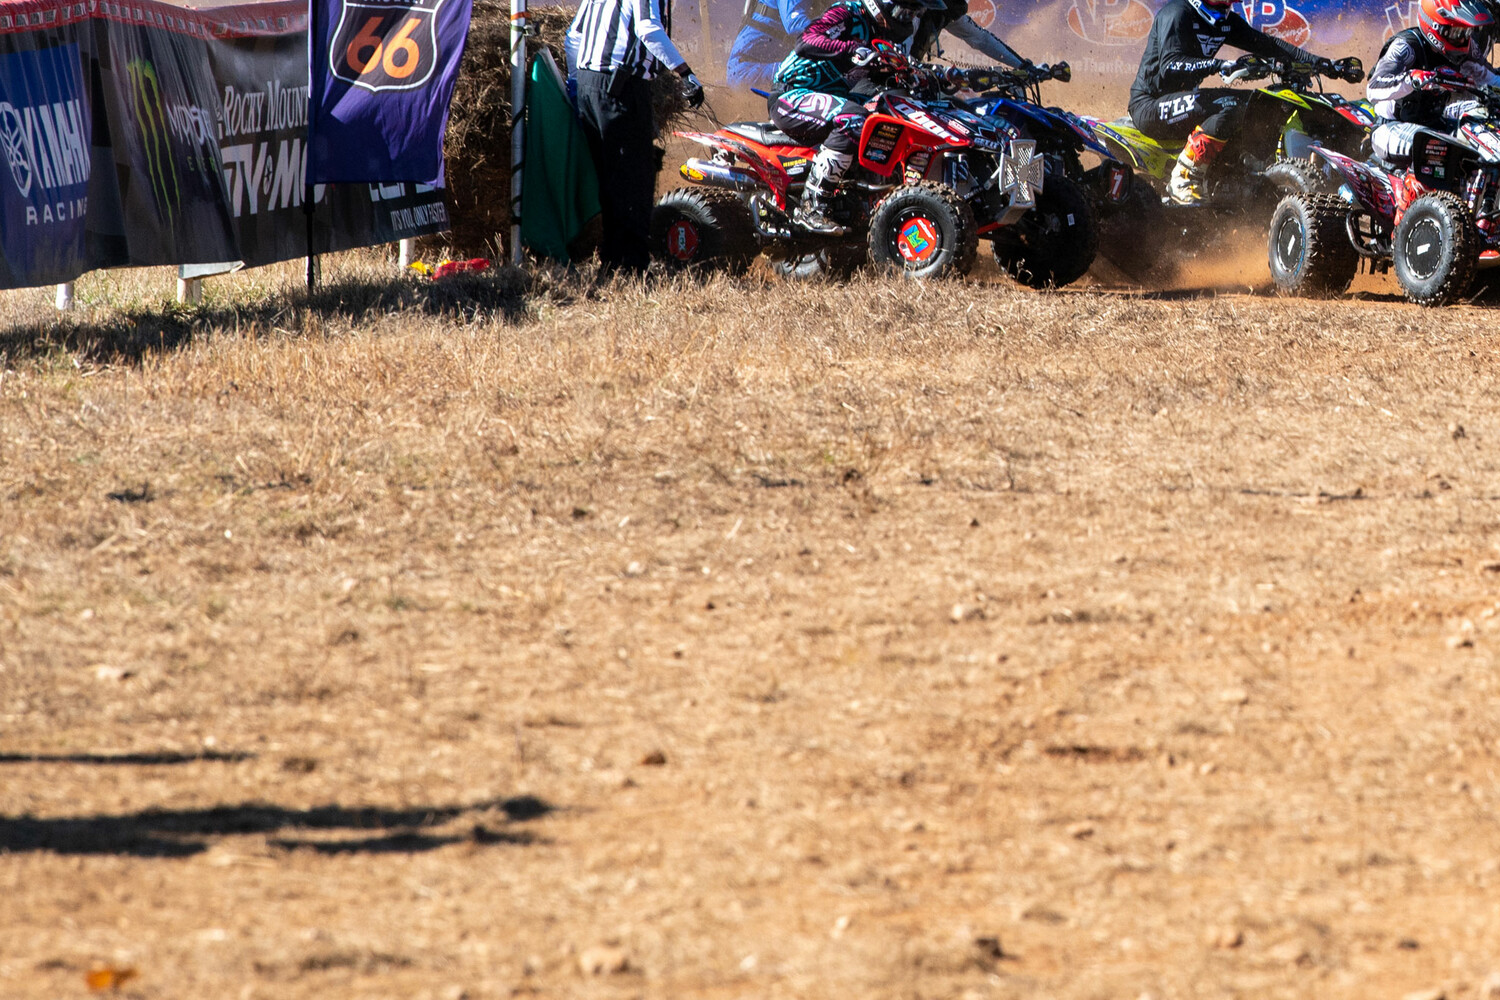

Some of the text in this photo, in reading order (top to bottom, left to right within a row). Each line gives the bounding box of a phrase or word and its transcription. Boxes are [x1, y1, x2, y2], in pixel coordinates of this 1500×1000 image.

[346, 16, 420, 79] 66
[224, 79, 308, 136] ROCKY MOUNT
[1158, 93, 1196, 120] FLY
